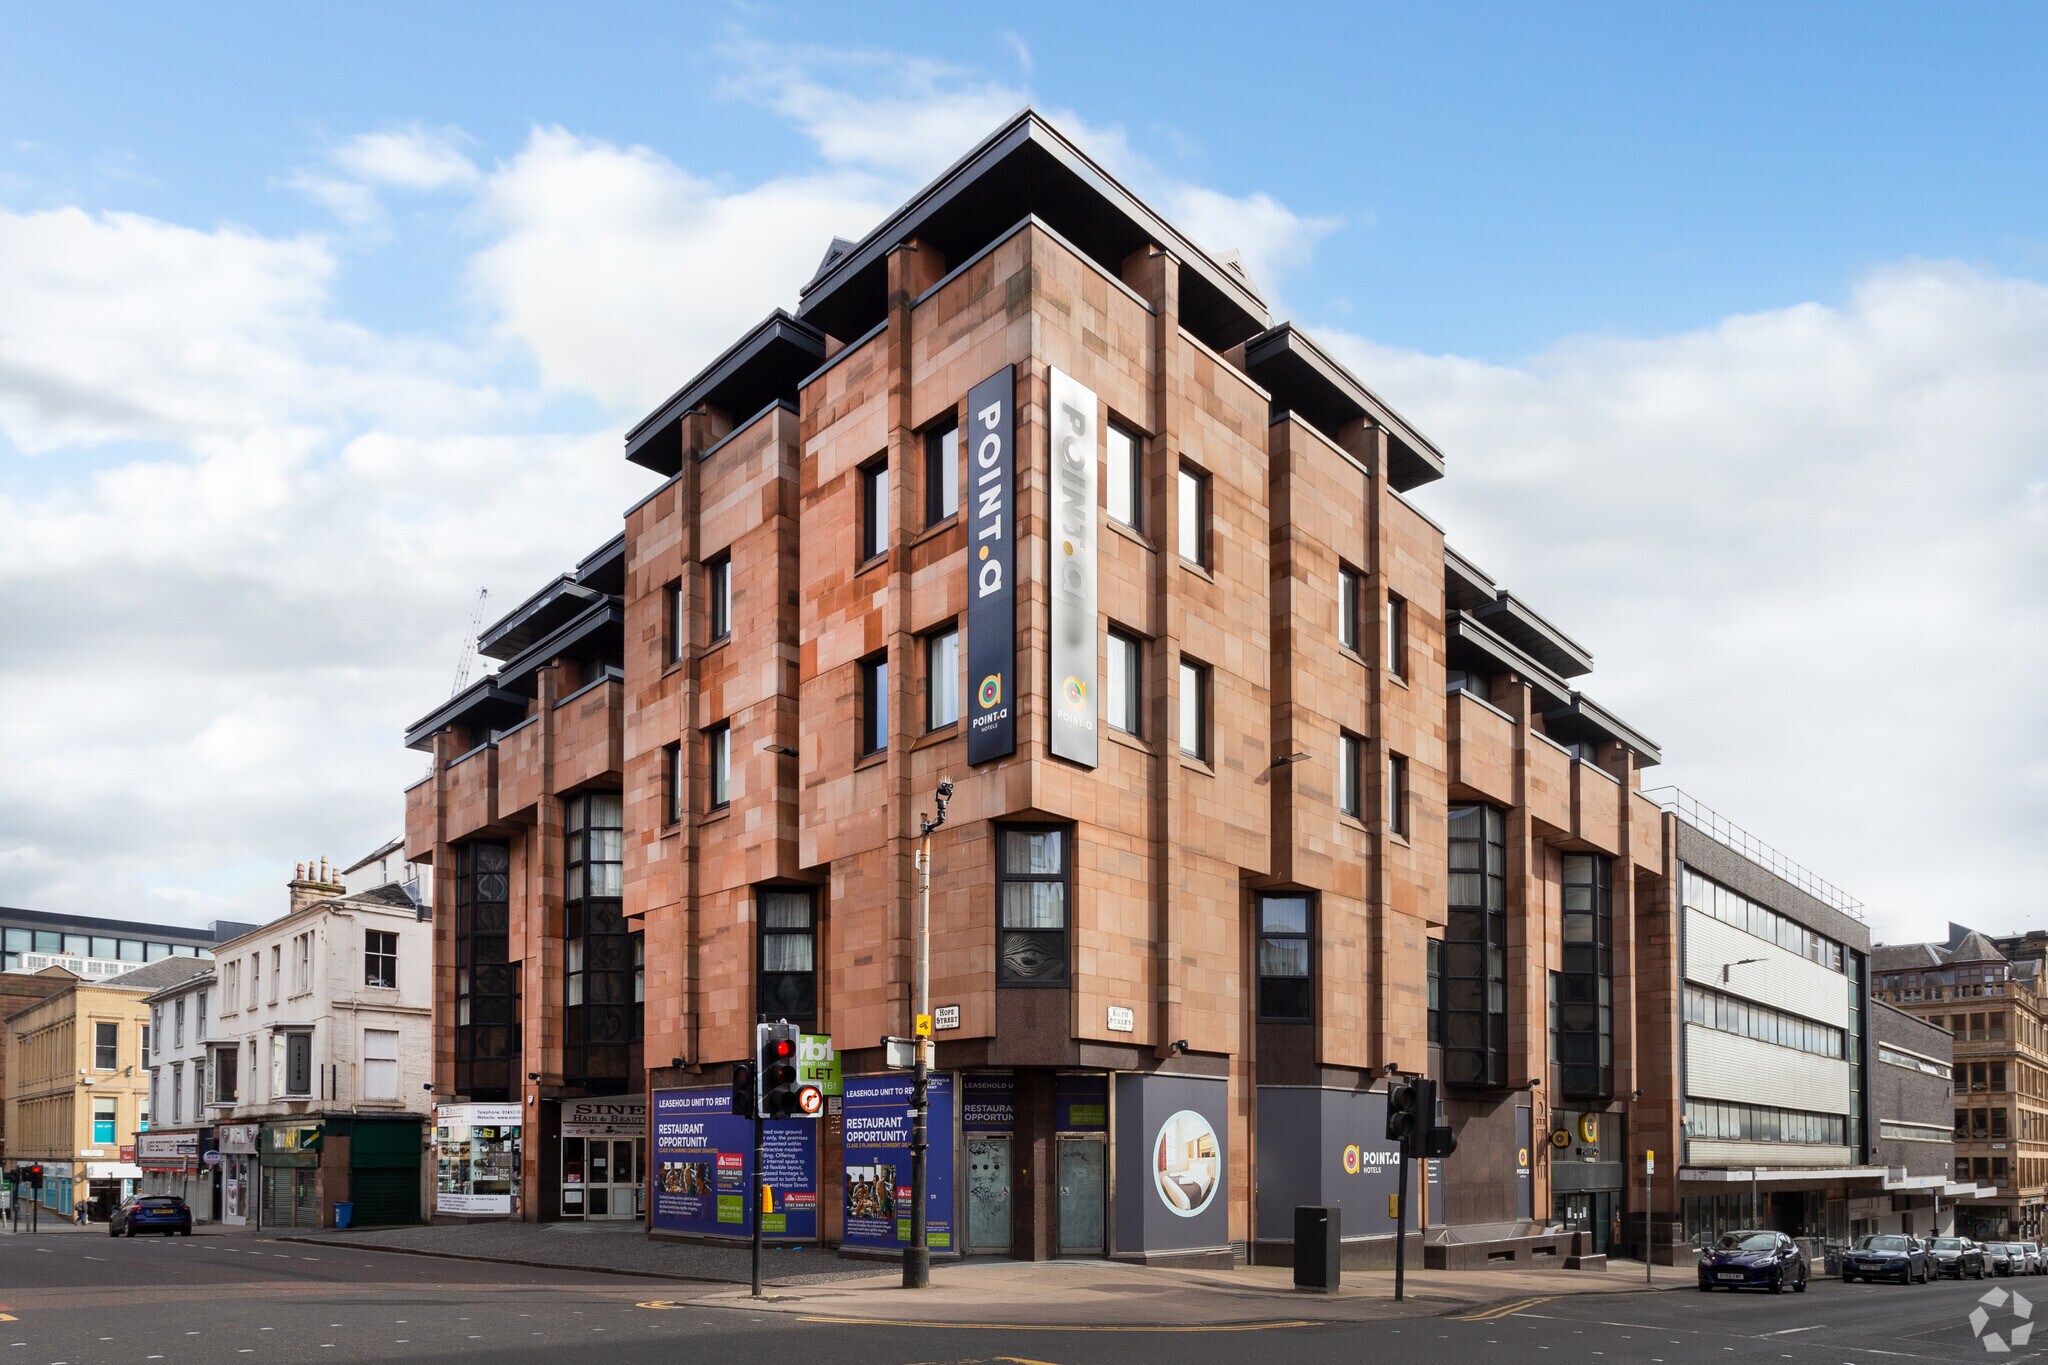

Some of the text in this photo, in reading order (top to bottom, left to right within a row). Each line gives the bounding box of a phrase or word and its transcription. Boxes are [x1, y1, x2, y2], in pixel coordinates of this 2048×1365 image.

[978, 400, 1002, 598] POINT.a
[972, 708, 1008, 728] POINT.a
[1057, 710, 1093, 730] POINT.a
[981, 722, 998, 732] HOTELS
[936, 1016, 958, 1024] STREET
[808, 1068, 833, 1080] LET
[659, 1097, 730, 1108] LEASEHOLD UNIT TO RENT
[576, 1104, 646, 1115] SINE
[846, 1117, 903, 1129] RESTAURANT
[659, 1124, 704, 1134] RESTAURANT
[659, 1137, 708, 1147] OPPORTUNITY
[846, 1131, 908, 1142] OPPORTUNITY
[1364, 1152, 1400, 1165] POINT.a
